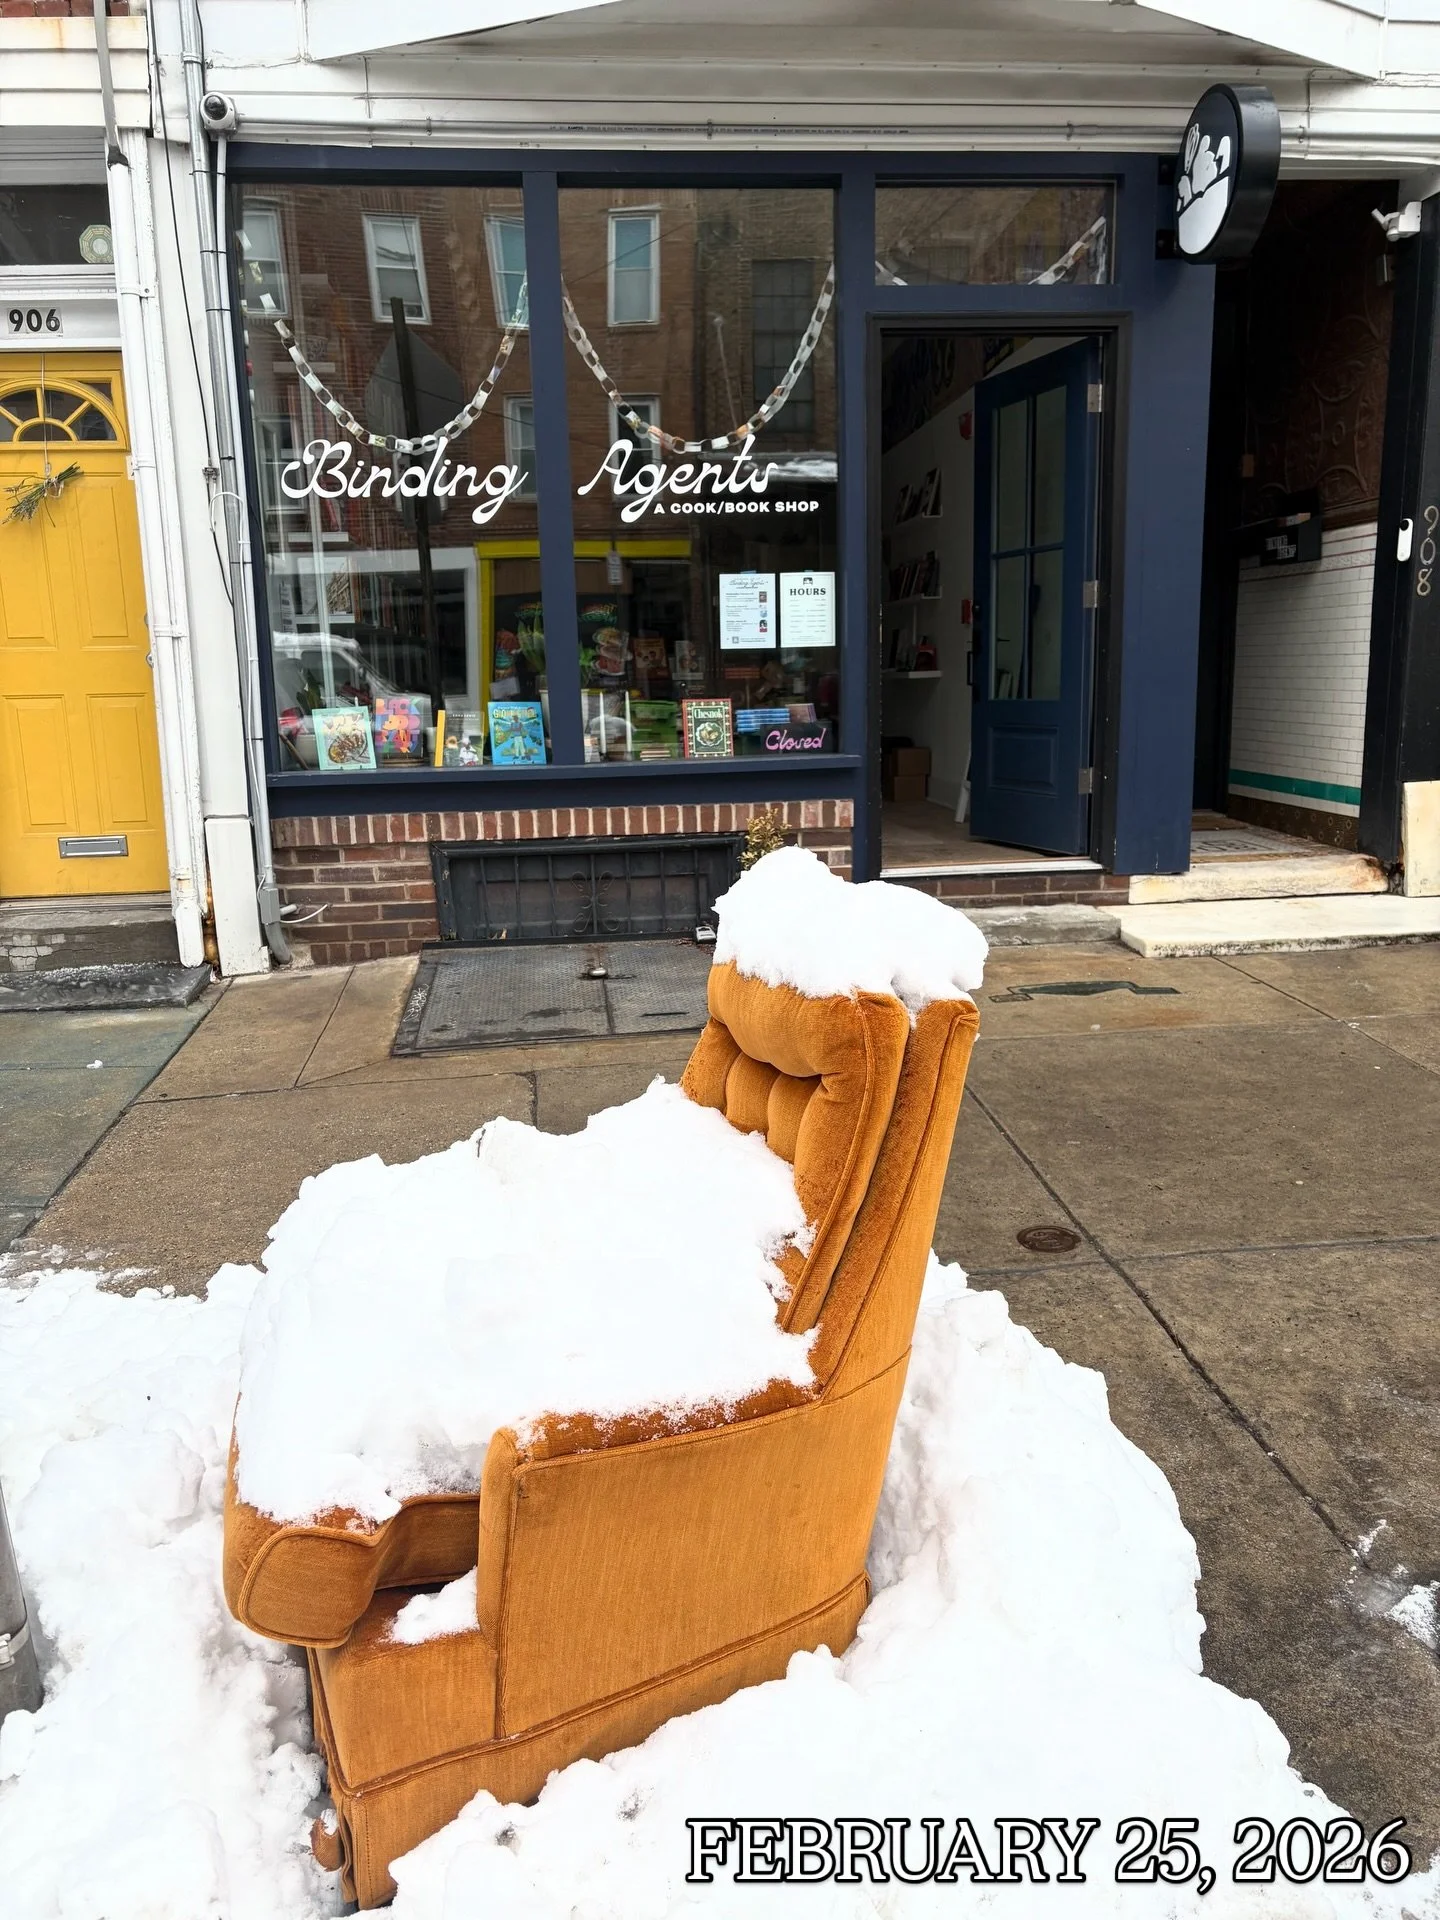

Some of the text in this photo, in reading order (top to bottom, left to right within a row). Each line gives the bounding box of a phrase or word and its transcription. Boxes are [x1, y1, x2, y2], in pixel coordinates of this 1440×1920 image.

[8, 308, 61, 333] 906
[281, 434, 779, 524] Binding Agents
[653, 500, 819, 514] A COOK/BOOK SHOP
[1416, 504, 1440, 597] 908
[789, 587, 827, 596] HOURS
[765, 728, 827, 751] Closed
